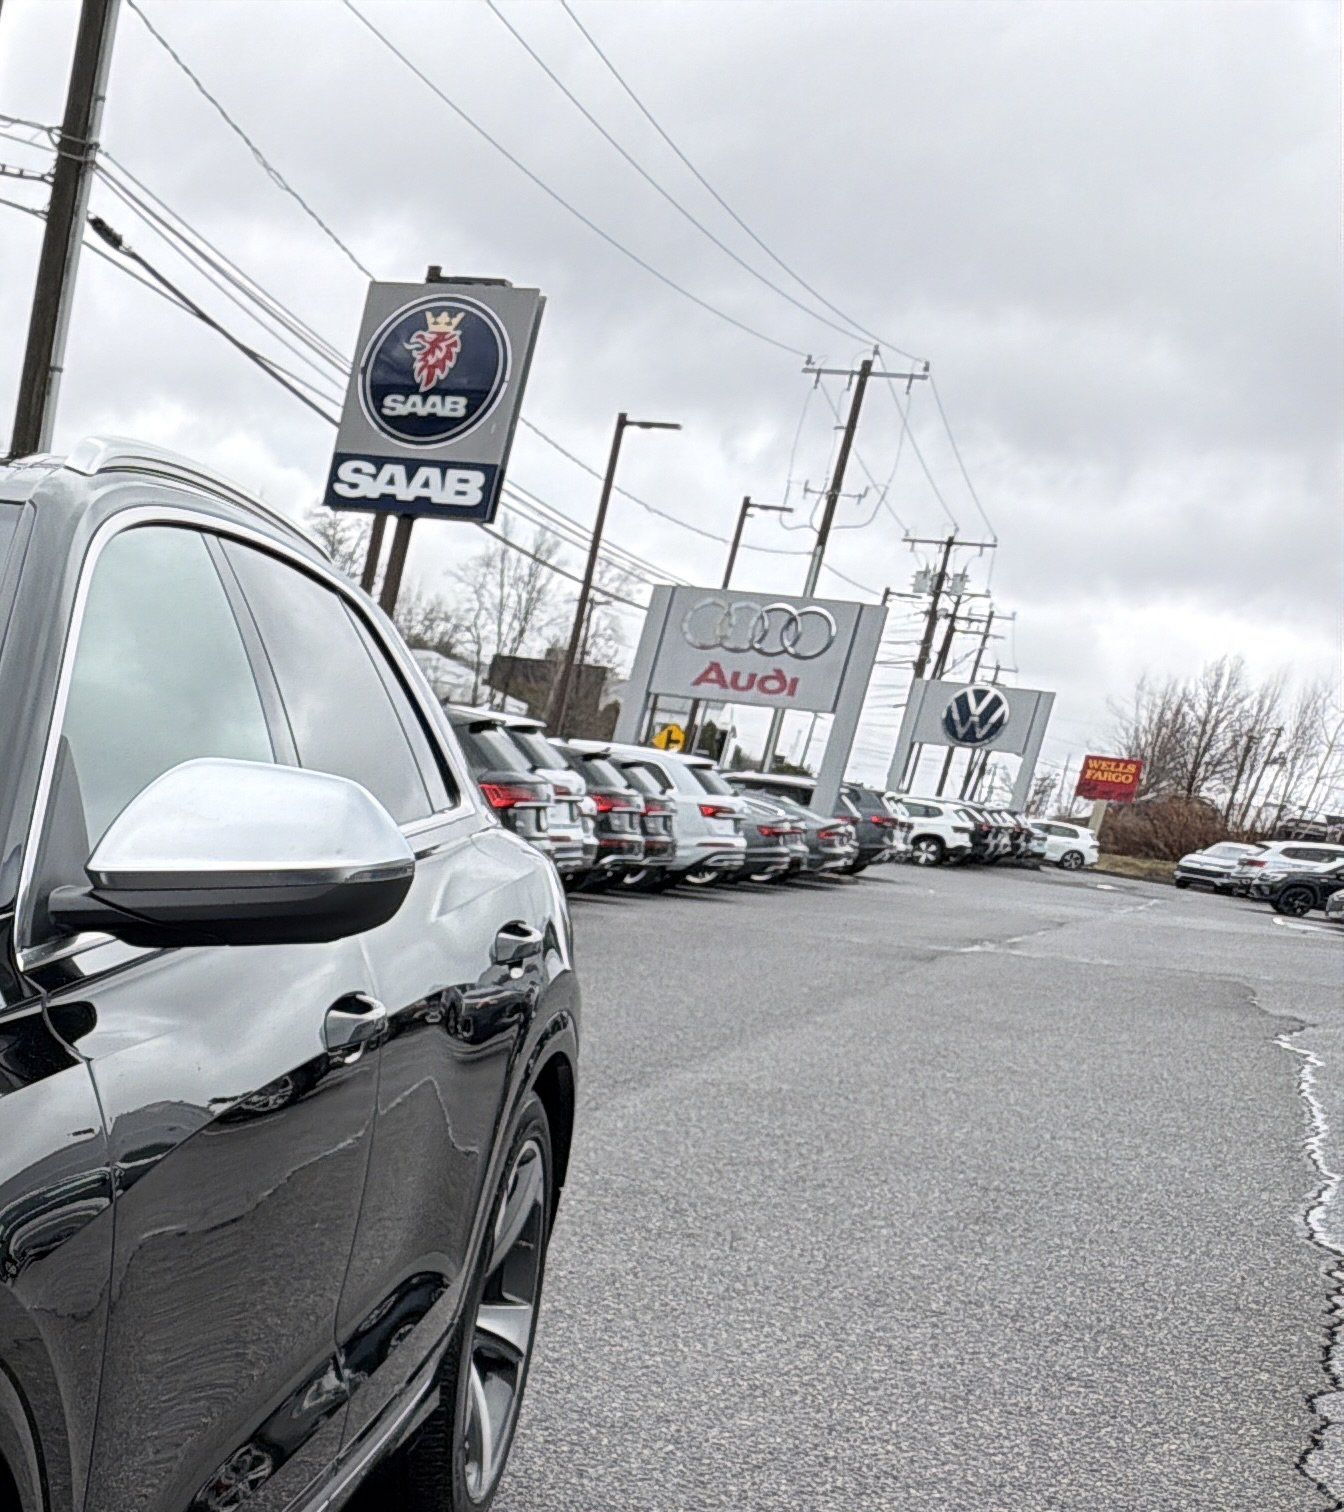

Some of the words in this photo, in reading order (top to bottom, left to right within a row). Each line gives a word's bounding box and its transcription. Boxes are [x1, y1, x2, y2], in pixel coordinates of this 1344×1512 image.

[381, 394, 468, 417] SAAB
[333, 459, 485, 506] SAAB
[691, 661, 799, 697] Audi
[1085, 769, 1133, 784] FARGO
[1087, 759, 1137, 773] WELLS
